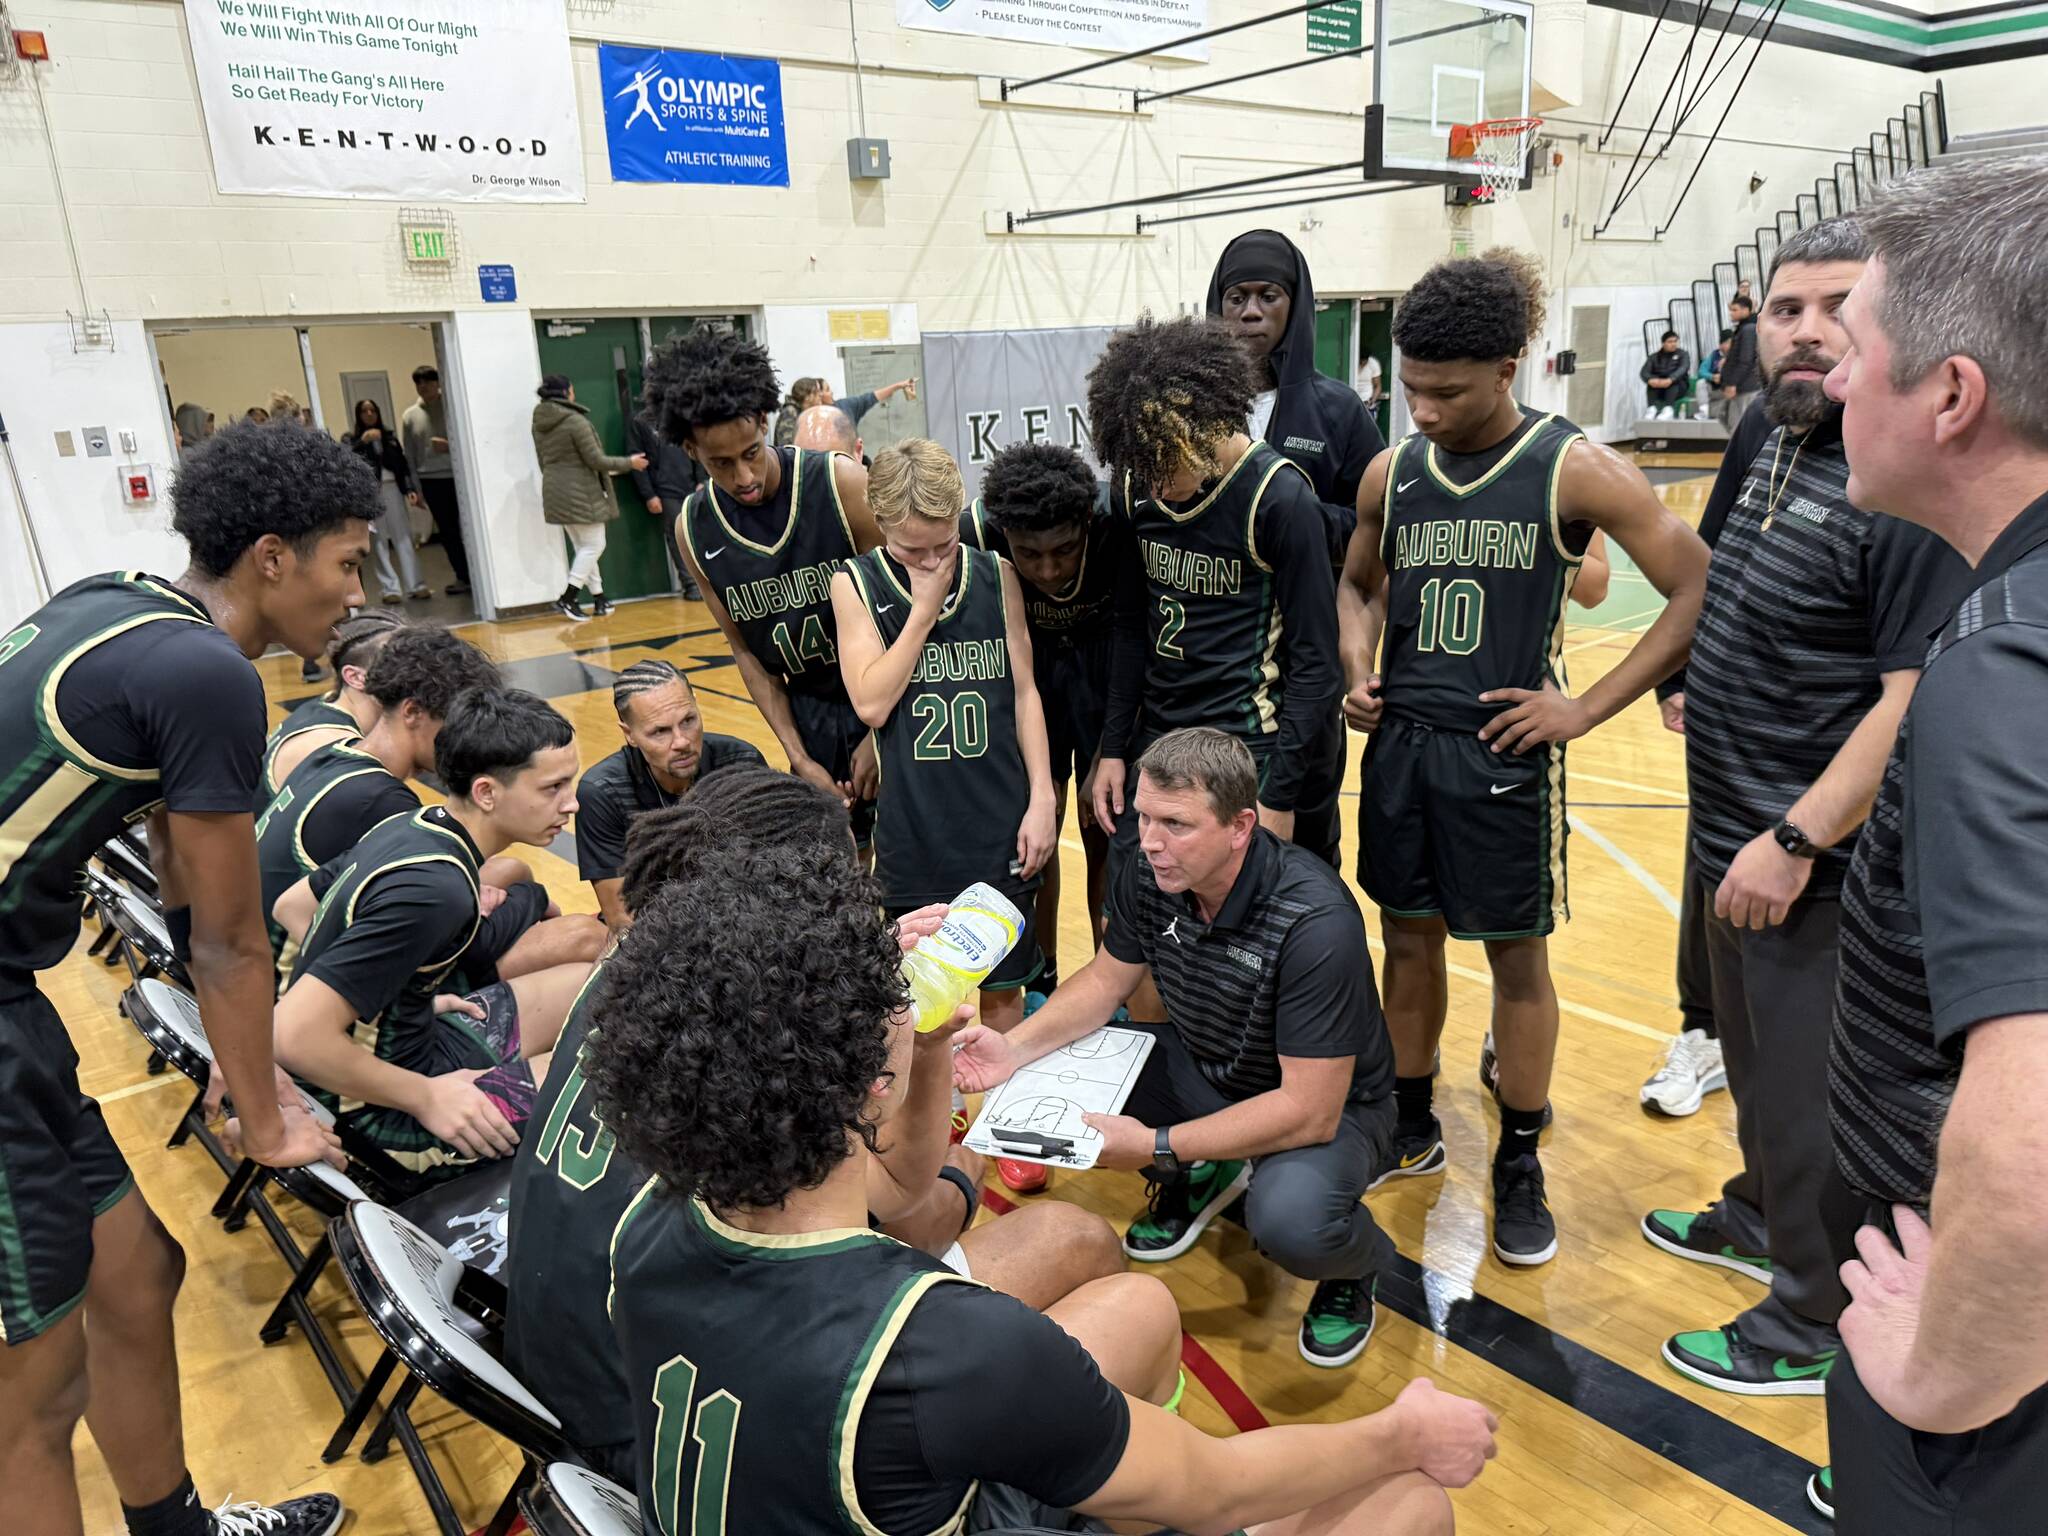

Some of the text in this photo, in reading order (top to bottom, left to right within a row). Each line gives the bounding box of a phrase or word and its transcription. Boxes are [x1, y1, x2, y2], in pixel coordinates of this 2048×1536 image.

[217, 0, 478, 39] We Will Fight With All Of Our Might
[982, 10, 1103, 33] PLEASE ENJOY THE CONTEST
[1028, 0, 1067, 12] THROUGH
[1069, 4, 1123, 19] COMPETITION
[1124, 13, 1141, 22] AND
[1142, 13, 1203, 29] SPORTSMANSHIP
[220, 21, 458, 57] We Will Win This Game Tonight
[228, 63, 444, 92] Hail Hail The Gang's All Here
[658, 76, 767, 109] OLYMPIC
[231, 84, 424, 112] So Get Ready For Victory
[661, 103, 768, 124] SPORTS & SPINE
[724, 125, 759, 137] MultiCare
[665, 150, 771, 168] ATHLETIC TRAINING
[472, 174, 561, 187] Dr. George Wilson
[412, 231, 447, 257] EXIT
[1394, 519, 1538, 570] AUBURN
[1137, 537, 1241, 596] UBURN
[1156, 595, 1186, 661] 2
[1417, 577, 1485, 656] 10
[772, 614, 837, 674] 14
[910, 638, 1006, 683] BURN
[912, 691, 989, 760] 20
[941, 922, 981, 962] Electro
[651, 1353, 742, 1536] 11
